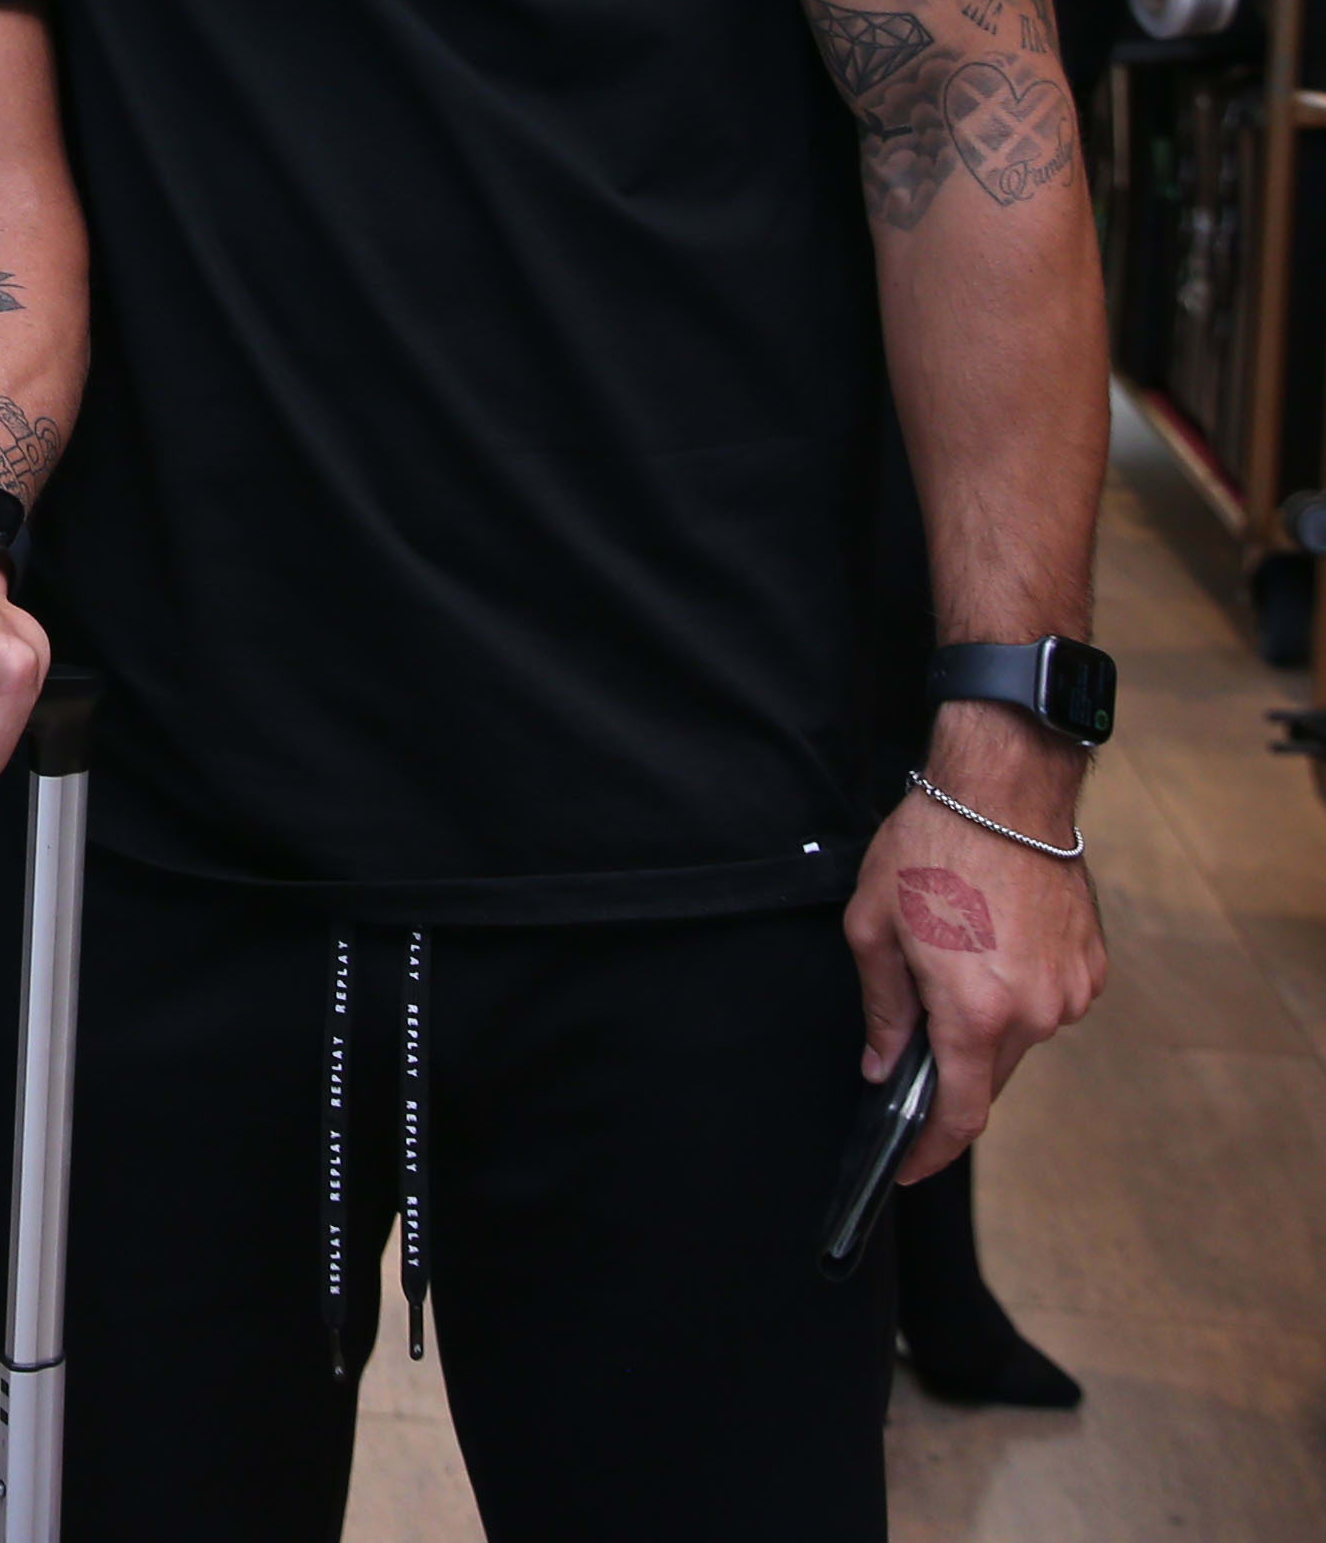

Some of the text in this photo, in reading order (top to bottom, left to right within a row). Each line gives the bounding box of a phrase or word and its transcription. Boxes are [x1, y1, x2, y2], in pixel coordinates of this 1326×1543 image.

[407, 1004, 419, 1077] REPLAY
[330, 941, 348, 1294] REPLAY REPLAY REPLAY REPLAY
[405, 1101, 418, 1171] REPLAY
[406, 1196, 419, 1266] REPLAY
